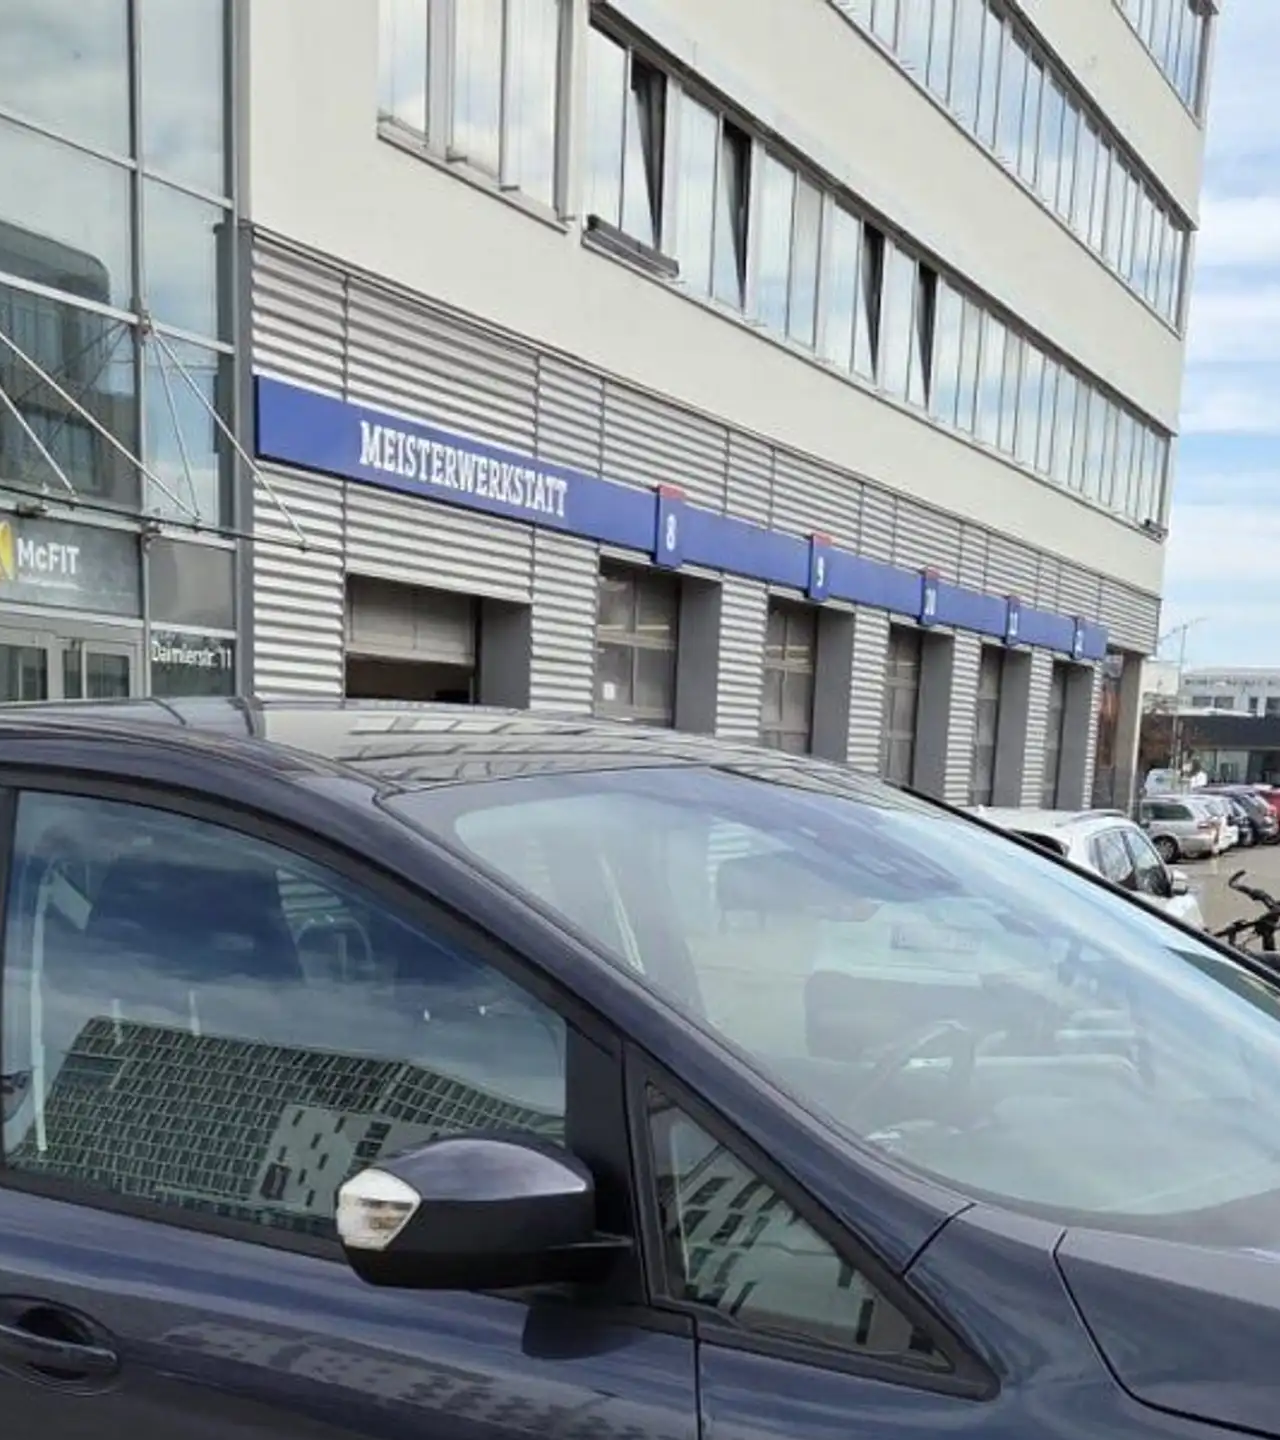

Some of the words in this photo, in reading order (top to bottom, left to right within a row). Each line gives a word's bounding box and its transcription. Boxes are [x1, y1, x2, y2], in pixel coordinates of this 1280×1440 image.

[359, 420, 568, 518] MEISTERWERKSTATT
[665, 513, 677, 552] 8
[16, 537, 80, 575] McFIT
